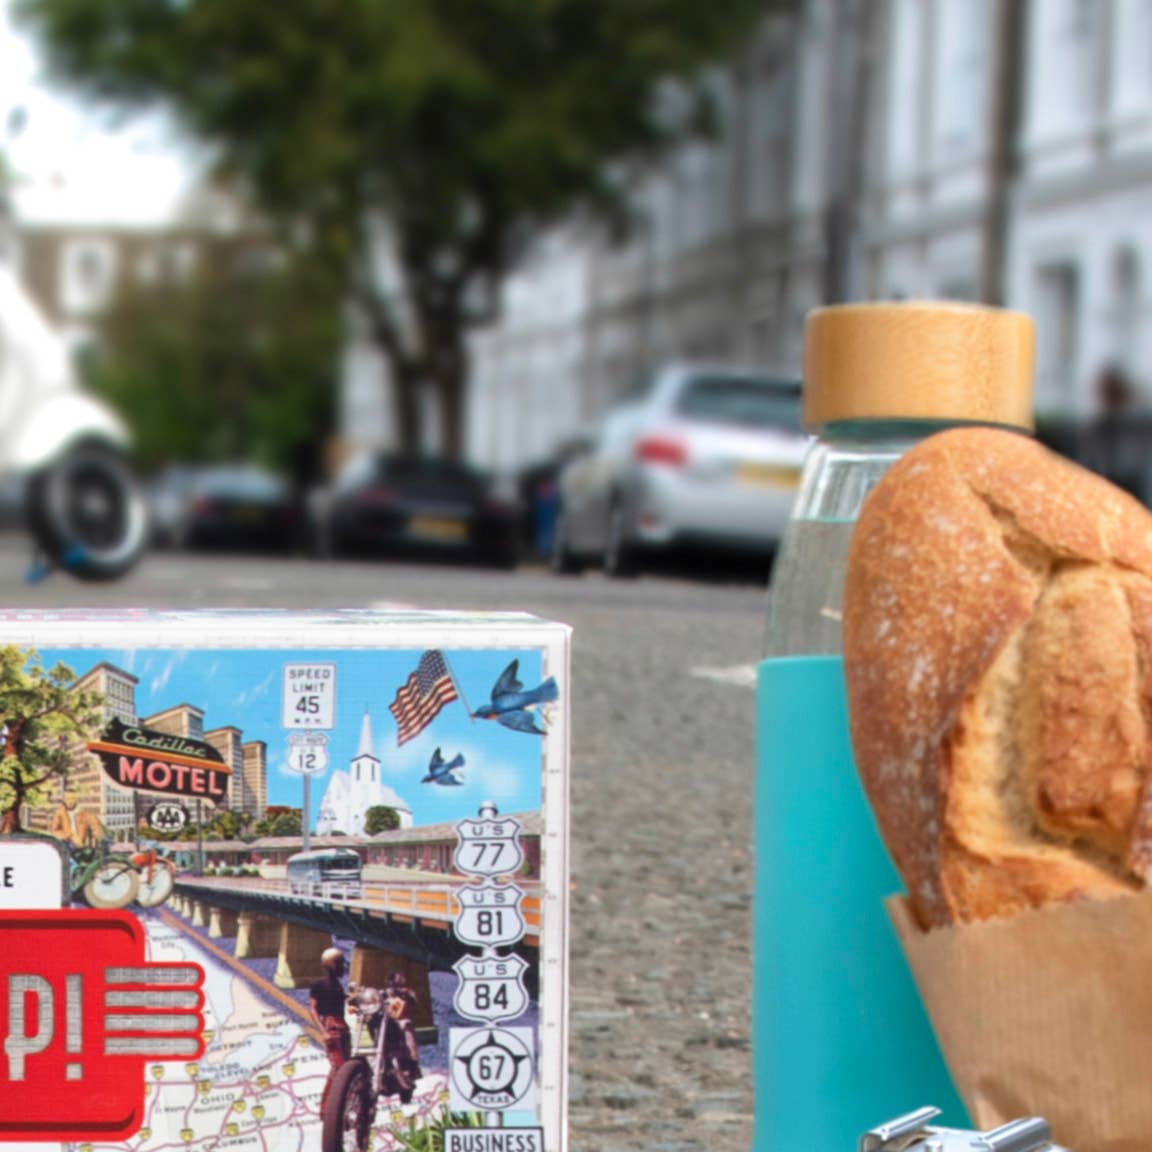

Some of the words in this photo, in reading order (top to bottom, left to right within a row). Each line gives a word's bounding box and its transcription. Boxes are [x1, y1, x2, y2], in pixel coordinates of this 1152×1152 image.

[288, 668, 331, 680] SPEED
[292, 682, 325, 693] LIMIT
[295, 695, 320, 714] 45
[121, 728, 207, 758] Cadillac
[298, 753, 317, 769] 12
[118, 756, 224, 796] MOTEL
[471, 842, 505, 868] 77
[476, 910, 503, 936] 81
[474, 983, 509, 1010] 84
[478, 1054, 506, 1081] 67
[200, 1092, 235, 1106] OHIO
[477, 1094, 511, 1104] TEXAS
